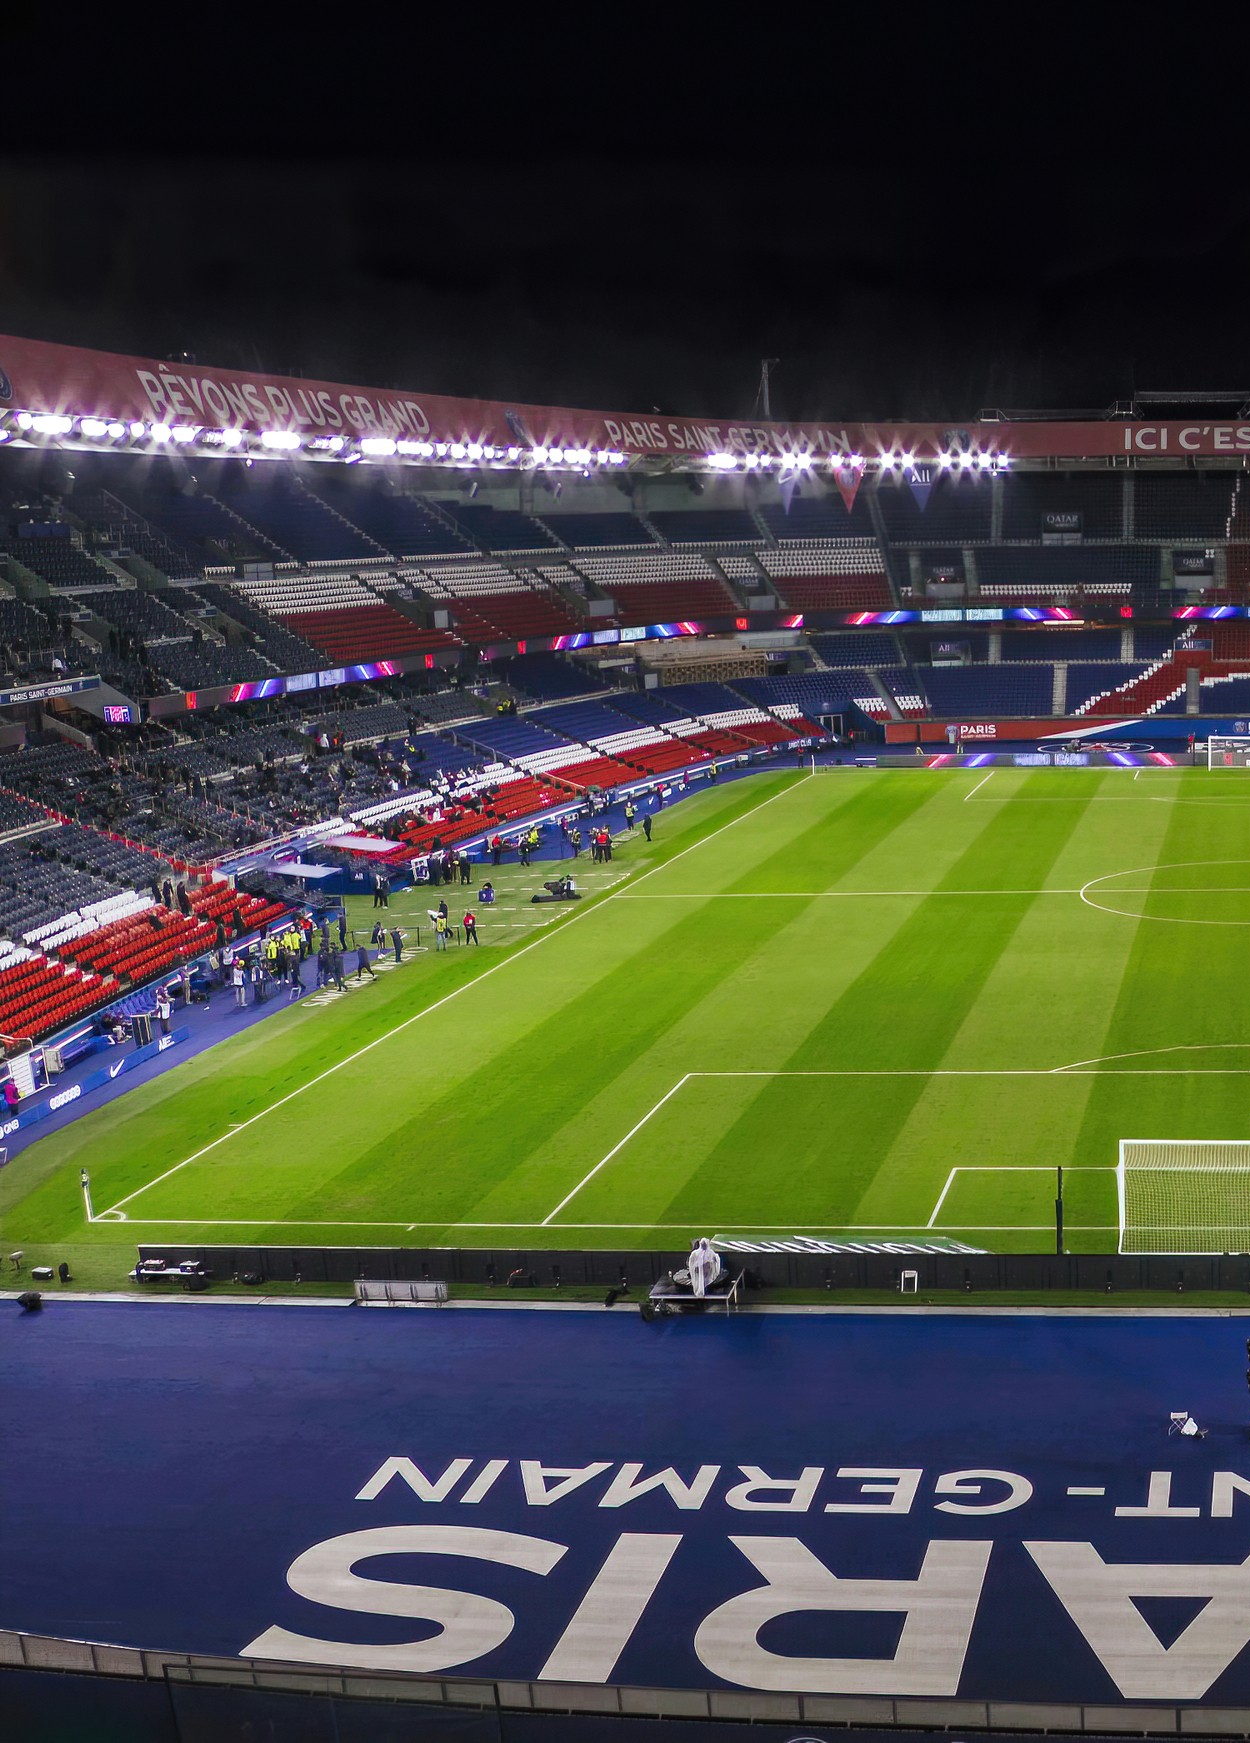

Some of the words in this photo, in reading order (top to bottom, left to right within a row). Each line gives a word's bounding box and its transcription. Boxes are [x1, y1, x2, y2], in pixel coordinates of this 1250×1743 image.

[136, 364, 270, 423] RÊVONS
[263, 385, 342, 428] PLUS
[339, 394, 430, 434] GRAND
[604, 420, 667, 449] PARIS
[667, 423, 851, 450] SAINT-GERMAIN
[1125, 428, 1167, 450] ICI
[1047, 515, 1079, 524] QATAR
[960, 724, 997, 735] PARIS
[353, 1455, 1035, 1517] GERMAIN
